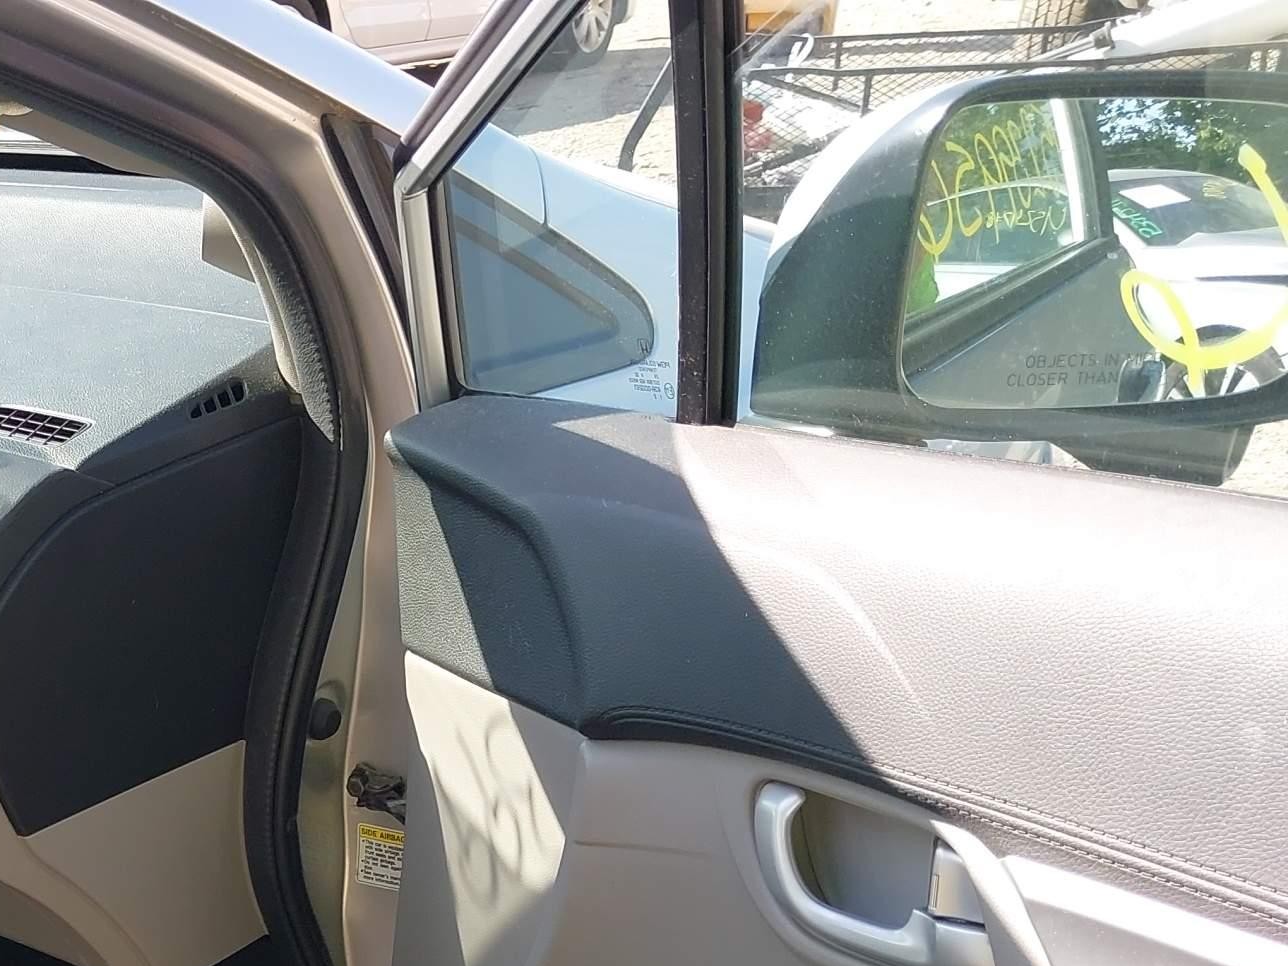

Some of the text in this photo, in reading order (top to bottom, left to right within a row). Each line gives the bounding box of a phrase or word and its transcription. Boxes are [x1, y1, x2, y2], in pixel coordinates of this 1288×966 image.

[1025, 353, 1097, 369] OBJECTS
[1103, 353, 1121, 368] IN
[1006, 372, 1068, 388] CLOSER
[1077, 371, 1119, 386] THAN
[361, 827, 377, 838] SIDE
